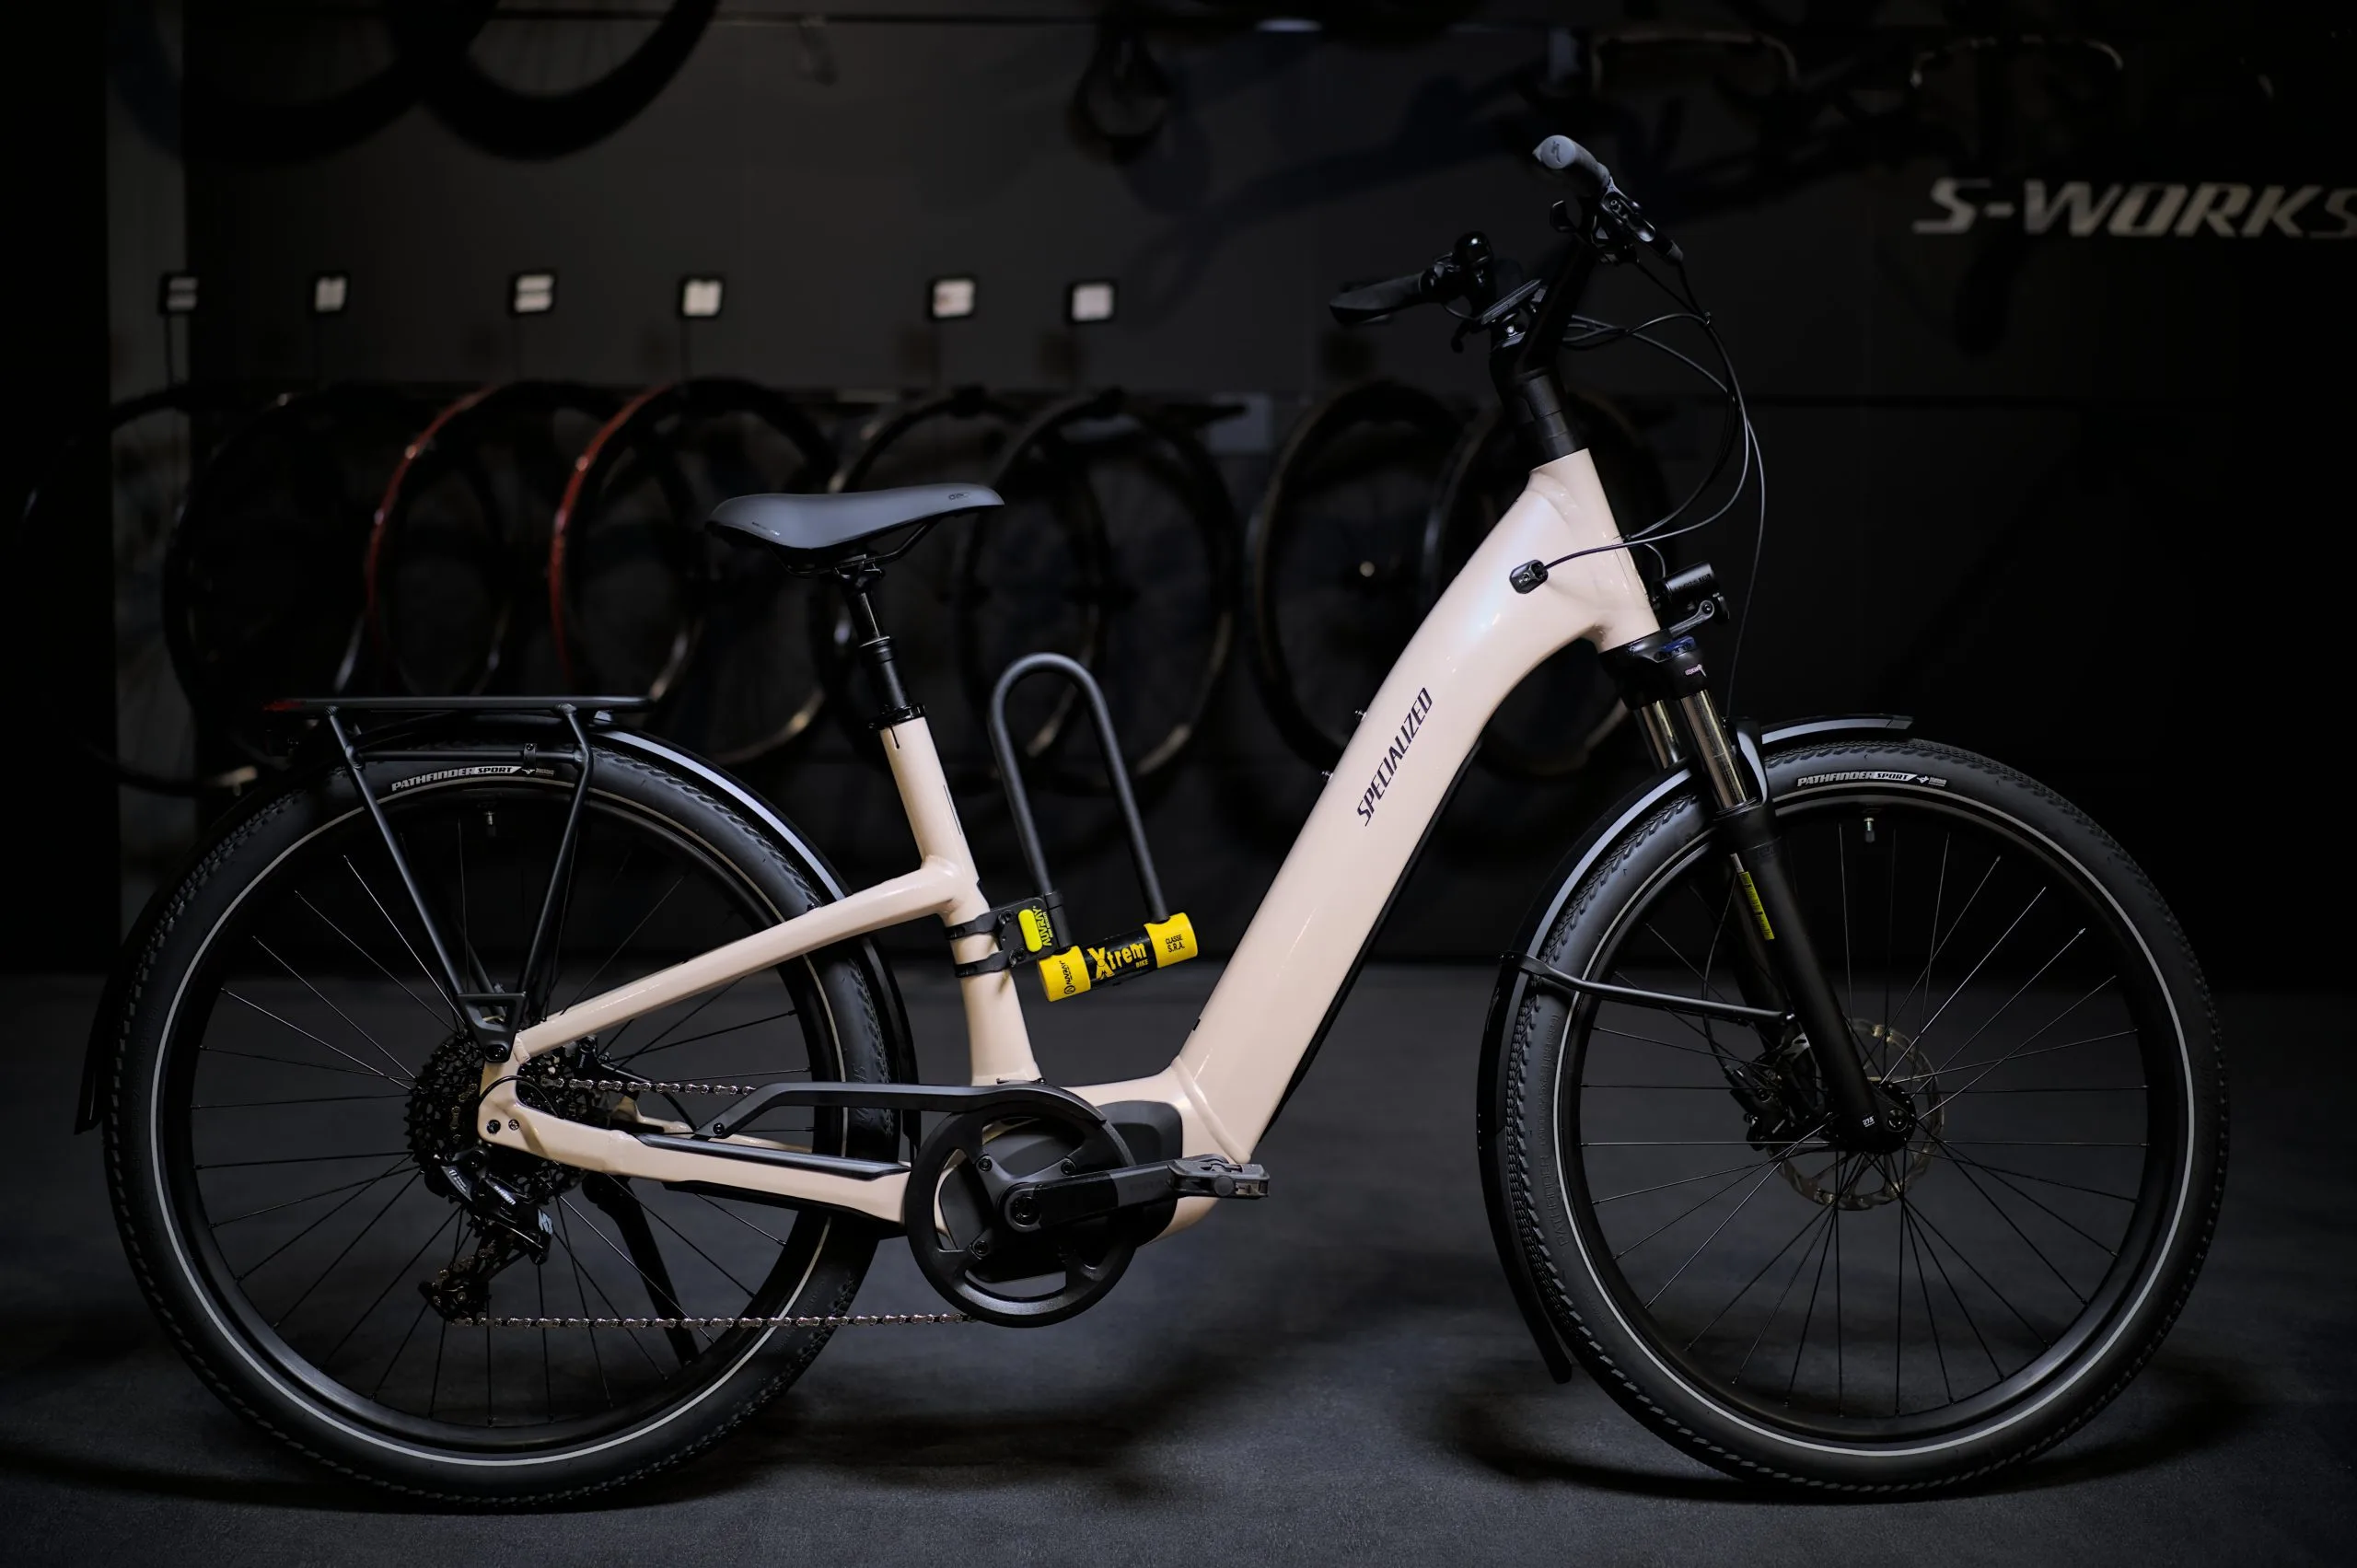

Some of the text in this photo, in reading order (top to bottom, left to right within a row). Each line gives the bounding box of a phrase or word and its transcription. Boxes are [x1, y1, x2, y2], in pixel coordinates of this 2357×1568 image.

[1912, 178, 2357, 238] S-WORKS
[1357, 687, 1433, 827] SPECIALIZED
[391, 766, 514, 791] PATHFINDER SPORT
[1797, 772, 1909, 786] PATHFINDER SPORT
[1032, 907, 1052, 947] AUVRAY
[1166, 934, 1182, 946] CLASSE
[1167, 942, 1185, 953] S.R.A.
[1087, 942, 1147, 980] Xtrem
[1135, 958, 1149, 969] BIKE
